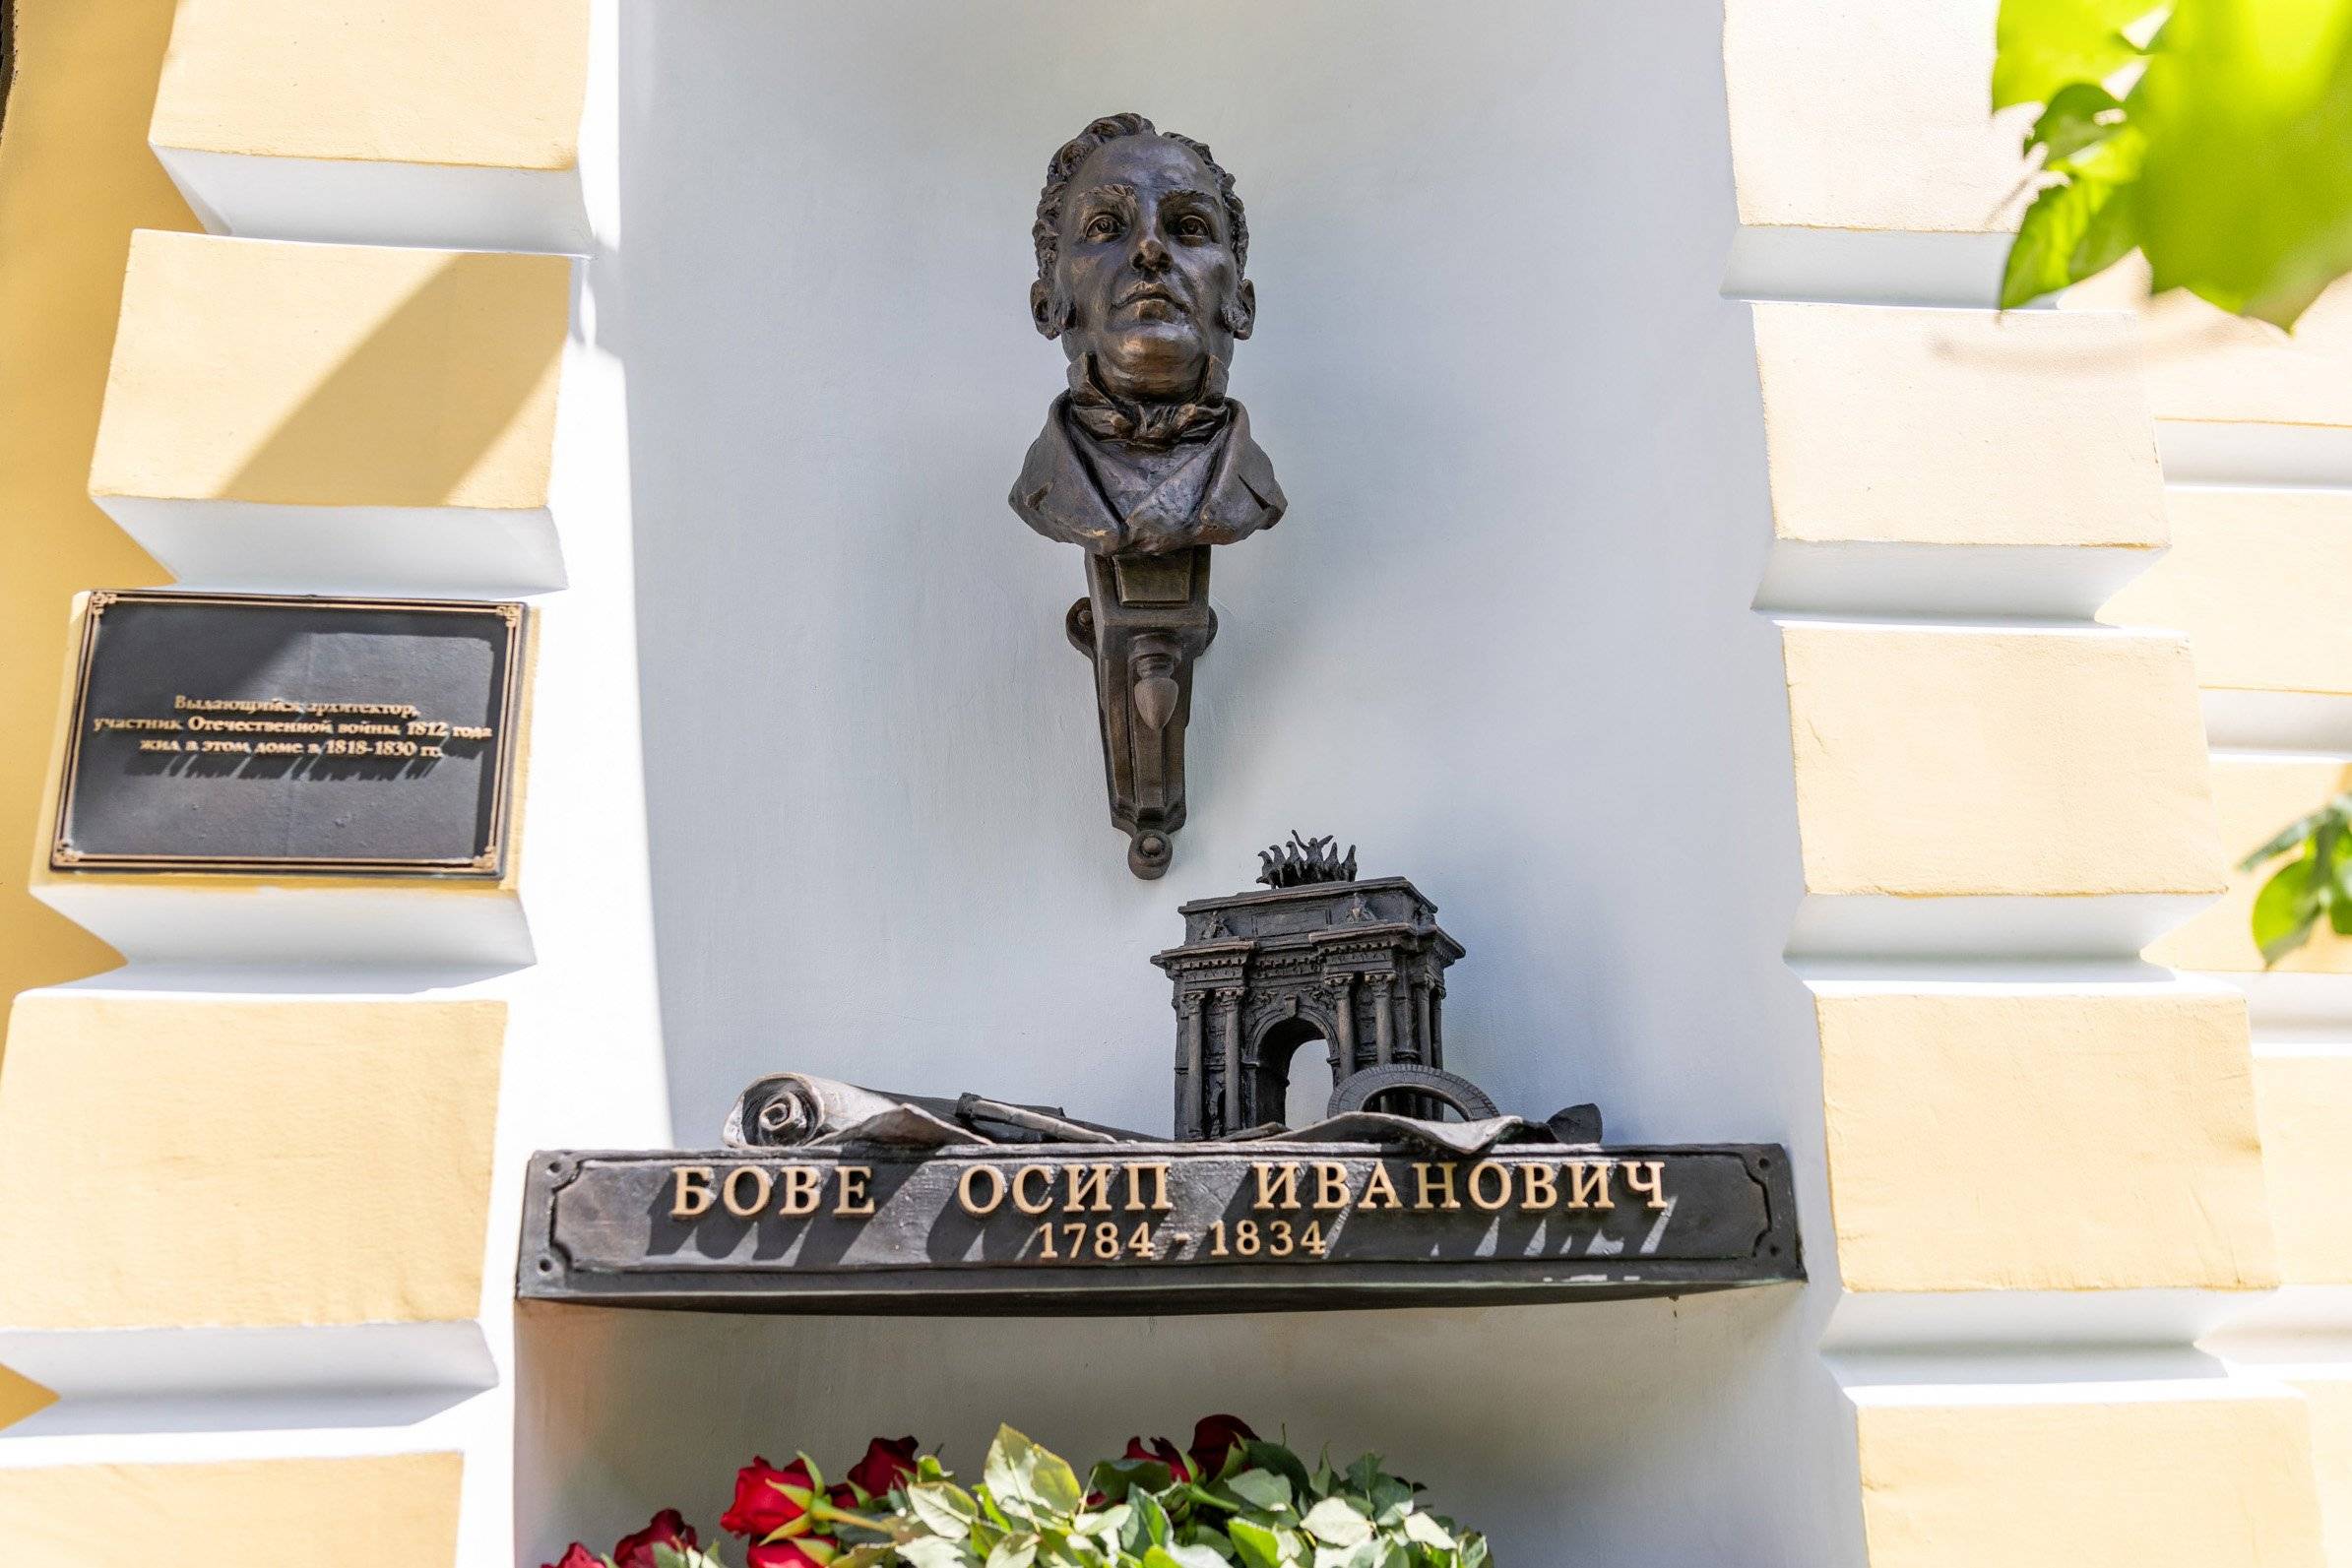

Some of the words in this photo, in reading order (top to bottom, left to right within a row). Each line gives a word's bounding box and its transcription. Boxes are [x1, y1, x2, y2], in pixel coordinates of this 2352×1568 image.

[174, 695, 302, 714] Выдающийся
[94, 718, 183, 732] участник
[188, 716, 333, 733] Отечественной
[338, 721, 400, 735] войны
[407, 721, 449, 737] 1812
[453, 726, 492, 738] года
[140, 739, 181, 752] жил
[185, 740, 198, 752] в
[202, 740, 251, 754] этом
[254, 741, 304, 754] доме
[307, 742, 322, 754] в
[326, 739, 417, 757] 1818-1830
[670, 1164, 875, 1219] БОВЕ
[958, 1161, 1174, 1214] ОСИП
[1252, 1160, 1669, 1210] ИВАНОВИЧ
[1039, 1221, 1155, 1259] 1784
[1210, 1219, 1326, 1256] 1834
